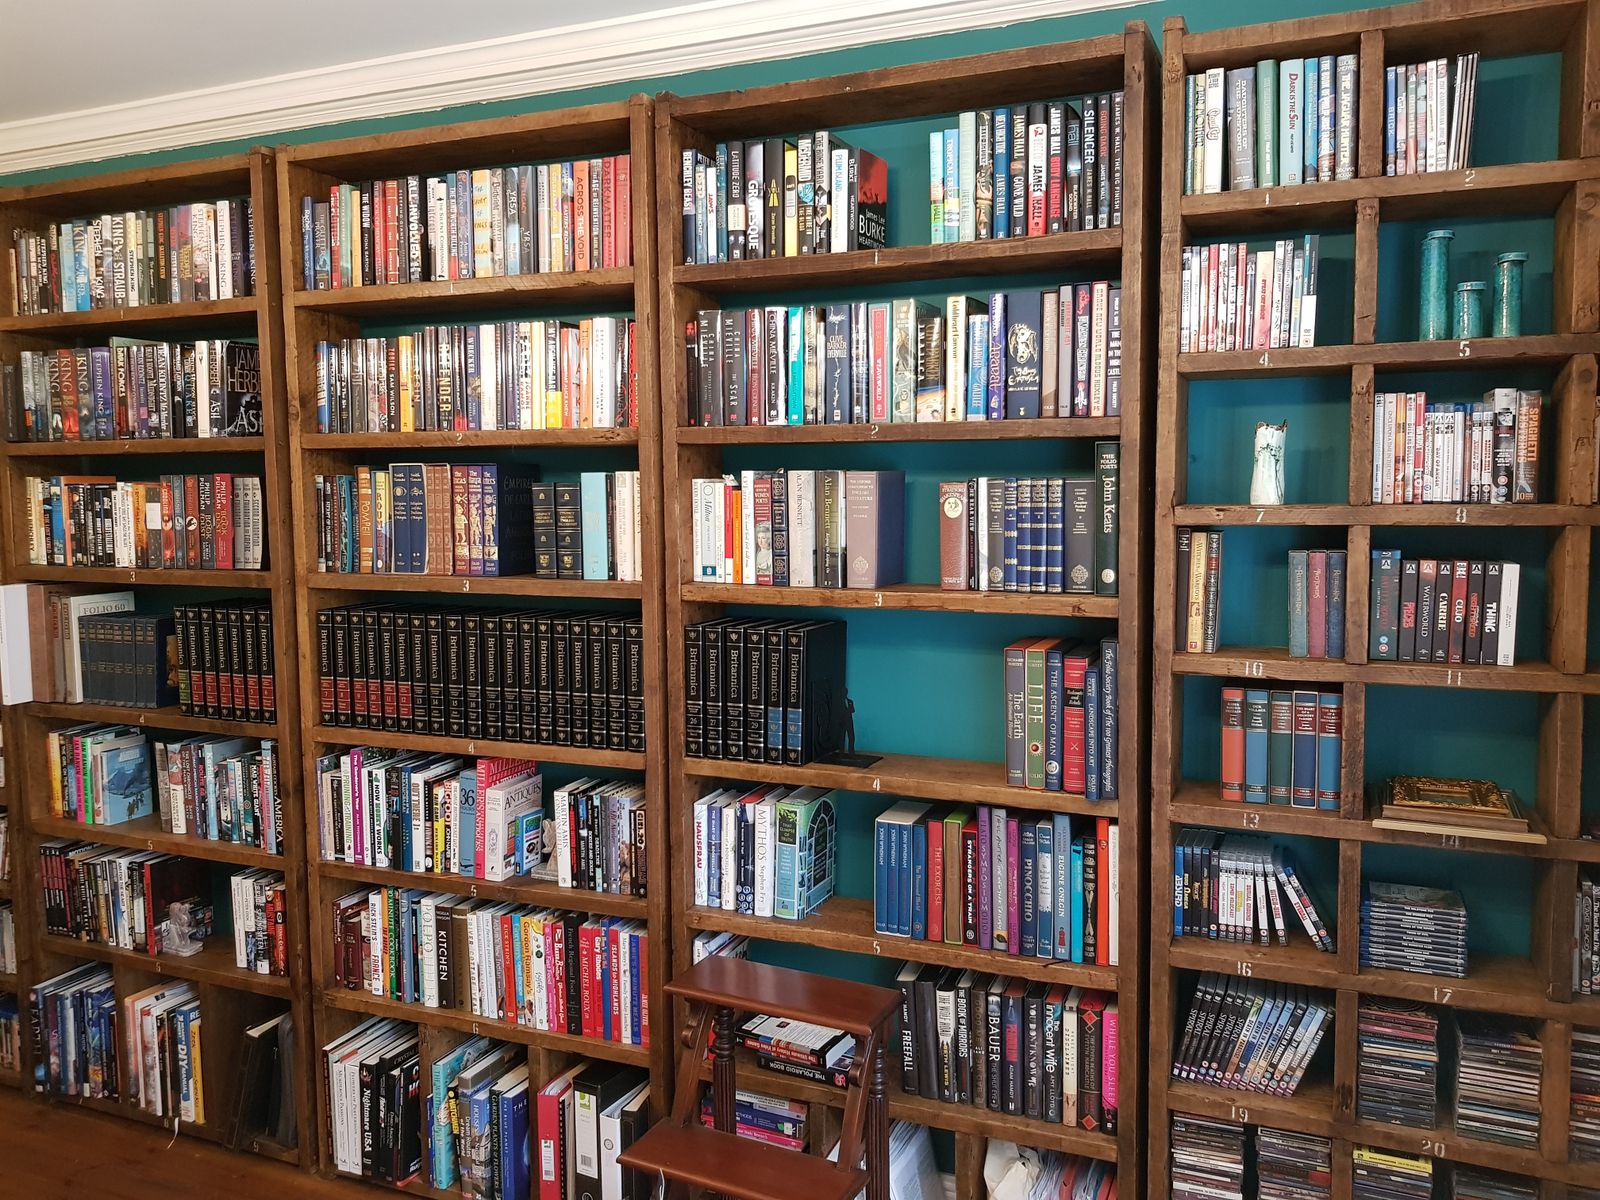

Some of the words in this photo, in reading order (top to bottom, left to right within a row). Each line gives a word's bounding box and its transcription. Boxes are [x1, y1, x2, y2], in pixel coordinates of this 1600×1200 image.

[1289, 73, 1298, 94] DARK
[1289, 114, 1298, 130] SUN
[731, 151, 739, 179] LATITUDE
[1464, 169, 1476, 186] 2
[748, 180, 759, 250] GROTESQUE
[112, 217, 124, 246] KING
[114, 262, 125, 298] STRAUB
[1259, 351, 1269, 367] 4
[1459, 341, 1471, 357] 5
[61, 358, 72, 391] KING
[77, 357, 89, 390] KING
[210, 400, 220, 418] ASH
[456, 432, 462, 444] 2
[871, 424, 878, 438] 2
[1518, 407, 1527, 463] WESTERNS
[1529, 408, 1538, 461] SPAGHETTI
[824, 476, 832, 495] Alan
[1102, 475, 1115, 501] John
[1104, 504, 1115, 533] Keats
[1255, 509, 1264, 522] 7
[1456, 508, 1467, 523] 8
[130, 572, 136, 582] 3
[464, 580, 470, 592] 3
[875, 594, 882, 607] 3
[1422, 586, 1430, 637] WATERWORLD
[1438, 593, 1447, 630] CARRIE
[1485, 602, 1496, 632] THING
[177, 624, 185, 665] Britannica
[321, 629, 330, 672] Britannica
[353, 631, 362, 673] Britannica
[383, 632, 392, 675] Britannica
[414, 634, 423, 678] Britannica
[450, 636, 459, 680] Britannica
[487, 638, 496, 682] Britannica
[523, 639, 532, 684] Britannica
[557, 640, 566, 686] Britannica
[593, 642, 602, 688] Britannica
[631, 644, 639, 691] Britannica
[1245, 662, 1263, 676] 10
[710, 649, 718, 696] Britannica
[751, 651, 760, 700] Britannica
[1448, 670, 1462, 686] 11
[1014, 692, 1023, 710] The
[1028, 684, 1043, 723] LIFE
[1014, 713, 1023, 738] Earth
[1050, 724, 1056, 734] OF
[468, 742, 474, 754] 4
[461, 788, 475, 805] 36
[872, 778, 880, 792] 4
[274, 797, 283, 842] AMERICA
[1243, 813, 1260, 828] 13
[470, 884, 476, 896] 5
[1024, 858, 1032, 921] PINOCCHIO
[522, 922, 531, 952] Gordon
[594, 936, 602, 956] Gary
[874, 941, 880, 954] 5
[438, 930, 448, 980] KITCHEN
[523, 955, 532, 994] Ramsay's
[581, 957, 589, 985] MICHEL
[1237, 961, 1252, 976] 16
[958, 998, 967, 1017] BOOK
[1434, 988, 1452, 1003] 17
[472, 1022, 478, 1034] 6
[1046, 1005, 1056, 1046] innocent
[1185, 1009, 1197, 1033] SPIRAL
[1193, 1011, 1207, 1036] SPIRAL
[1202, 1013, 1215, 1037] SPIRAL
[1212, 1013, 1227, 1037] SPIRAL
[1223, 1015, 1236, 1038] SPIRAL
[1230, 1018, 1244, 1041] SPIRAL
[902, 1030, 913, 1071] FREEFALL
[959, 1025, 967, 1057] MIRRORS
[178, 1045, 187, 1068] DIY
[1046, 1049, 1058, 1072] wife
[363, 1088, 372, 1129] Nightmare
[449, 1098, 458, 1134] WATCHMEN
[1232, 1106, 1248, 1122] 19
[364, 1132, 372, 1152] USA
[1422, 1140, 1445, 1157] 20
